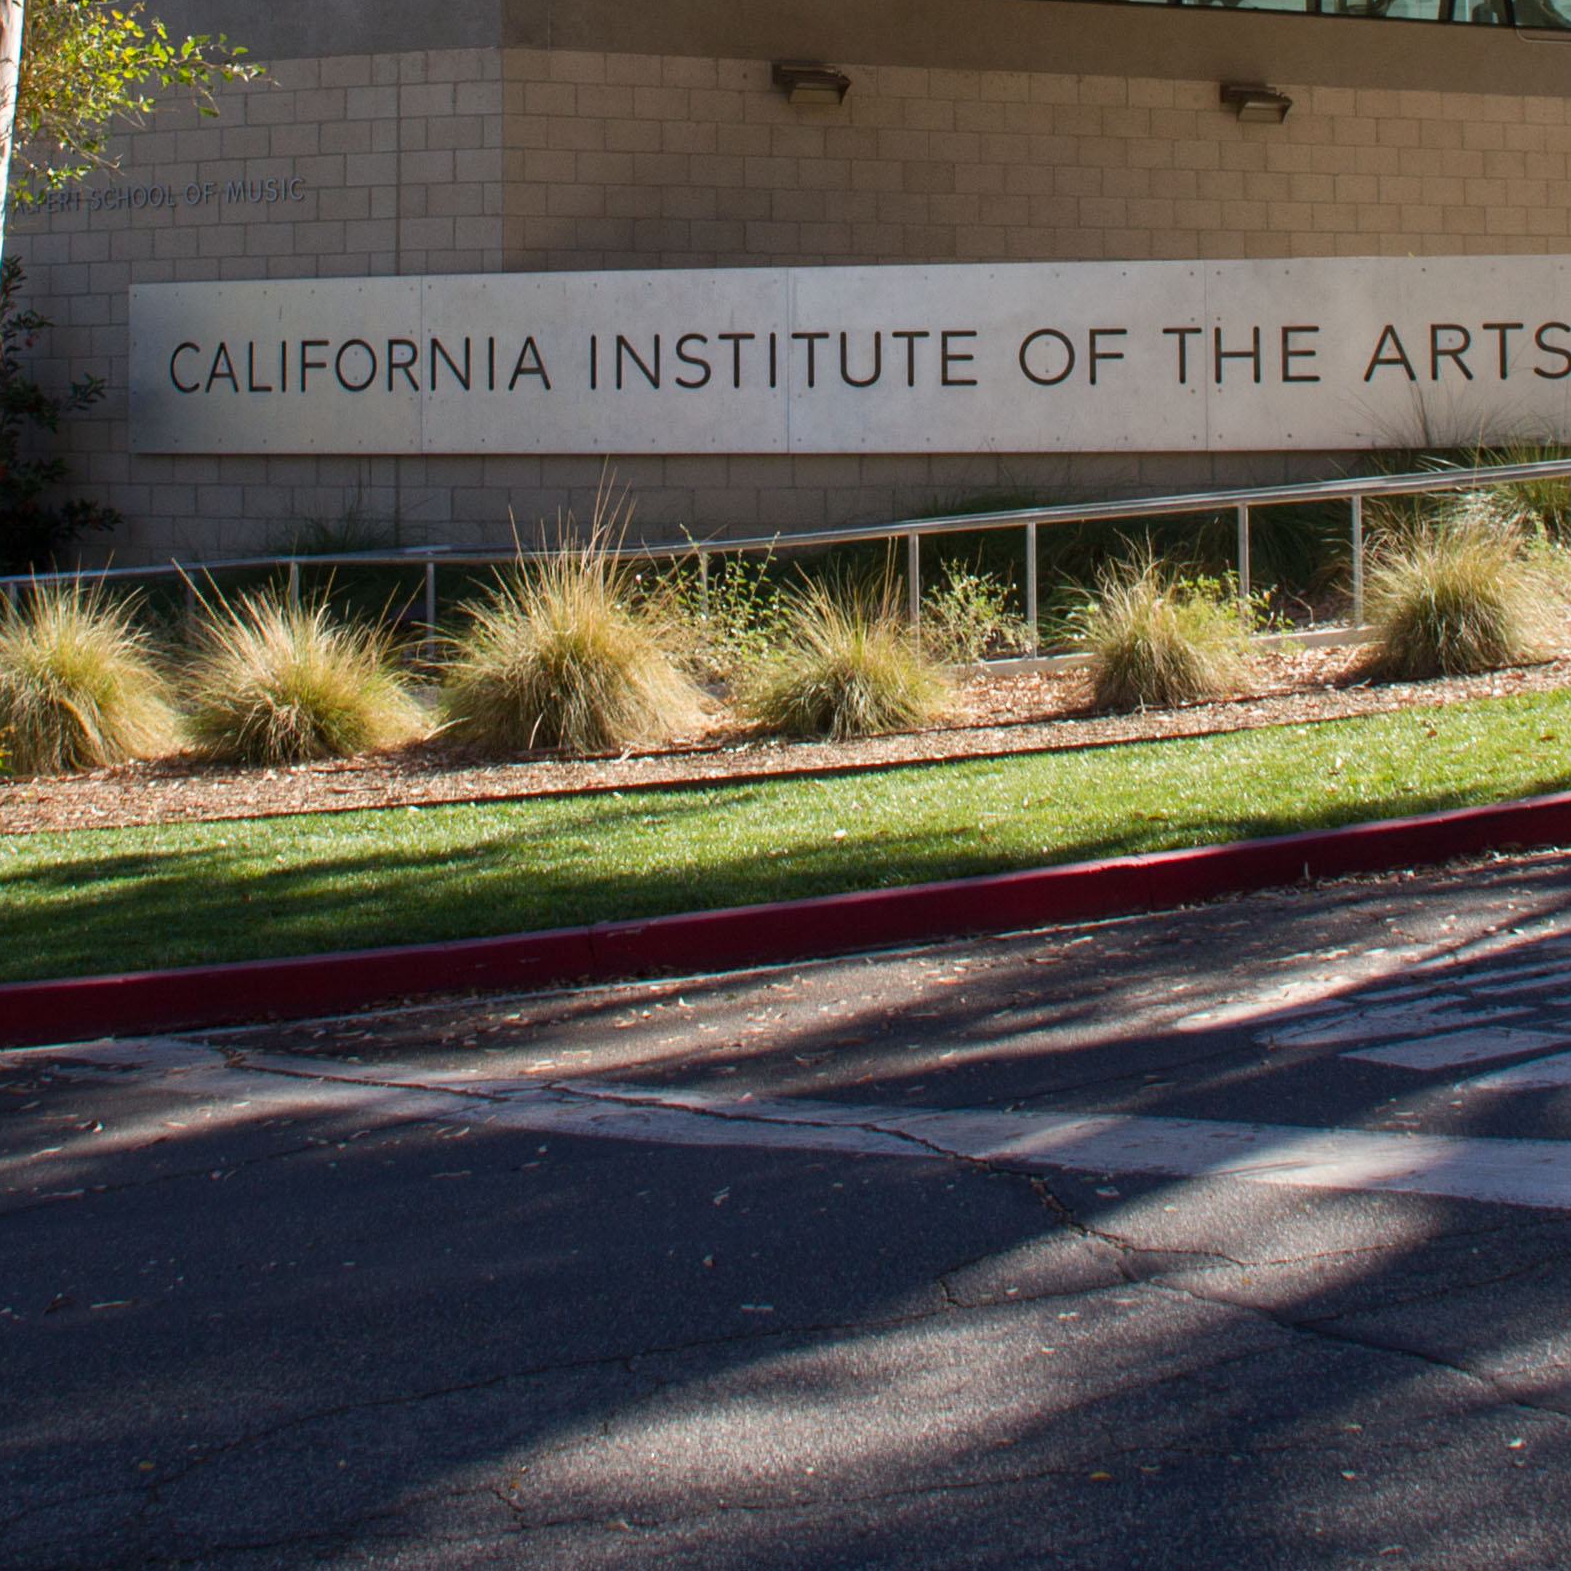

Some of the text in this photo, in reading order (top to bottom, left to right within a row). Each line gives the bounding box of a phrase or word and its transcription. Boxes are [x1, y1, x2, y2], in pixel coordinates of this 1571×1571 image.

[90, 185, 176, 210] SCHOOL
[184, 182, 217, 204] OF
[226, 178, 306, 203] MUSIC
[169, 336, 550, 393] CALIFORNIA
[590, 330, 978, 389] INSTITUTE
[1019, 328, 1128, 387] OF
[1162, 325, 1321, 384] THE
